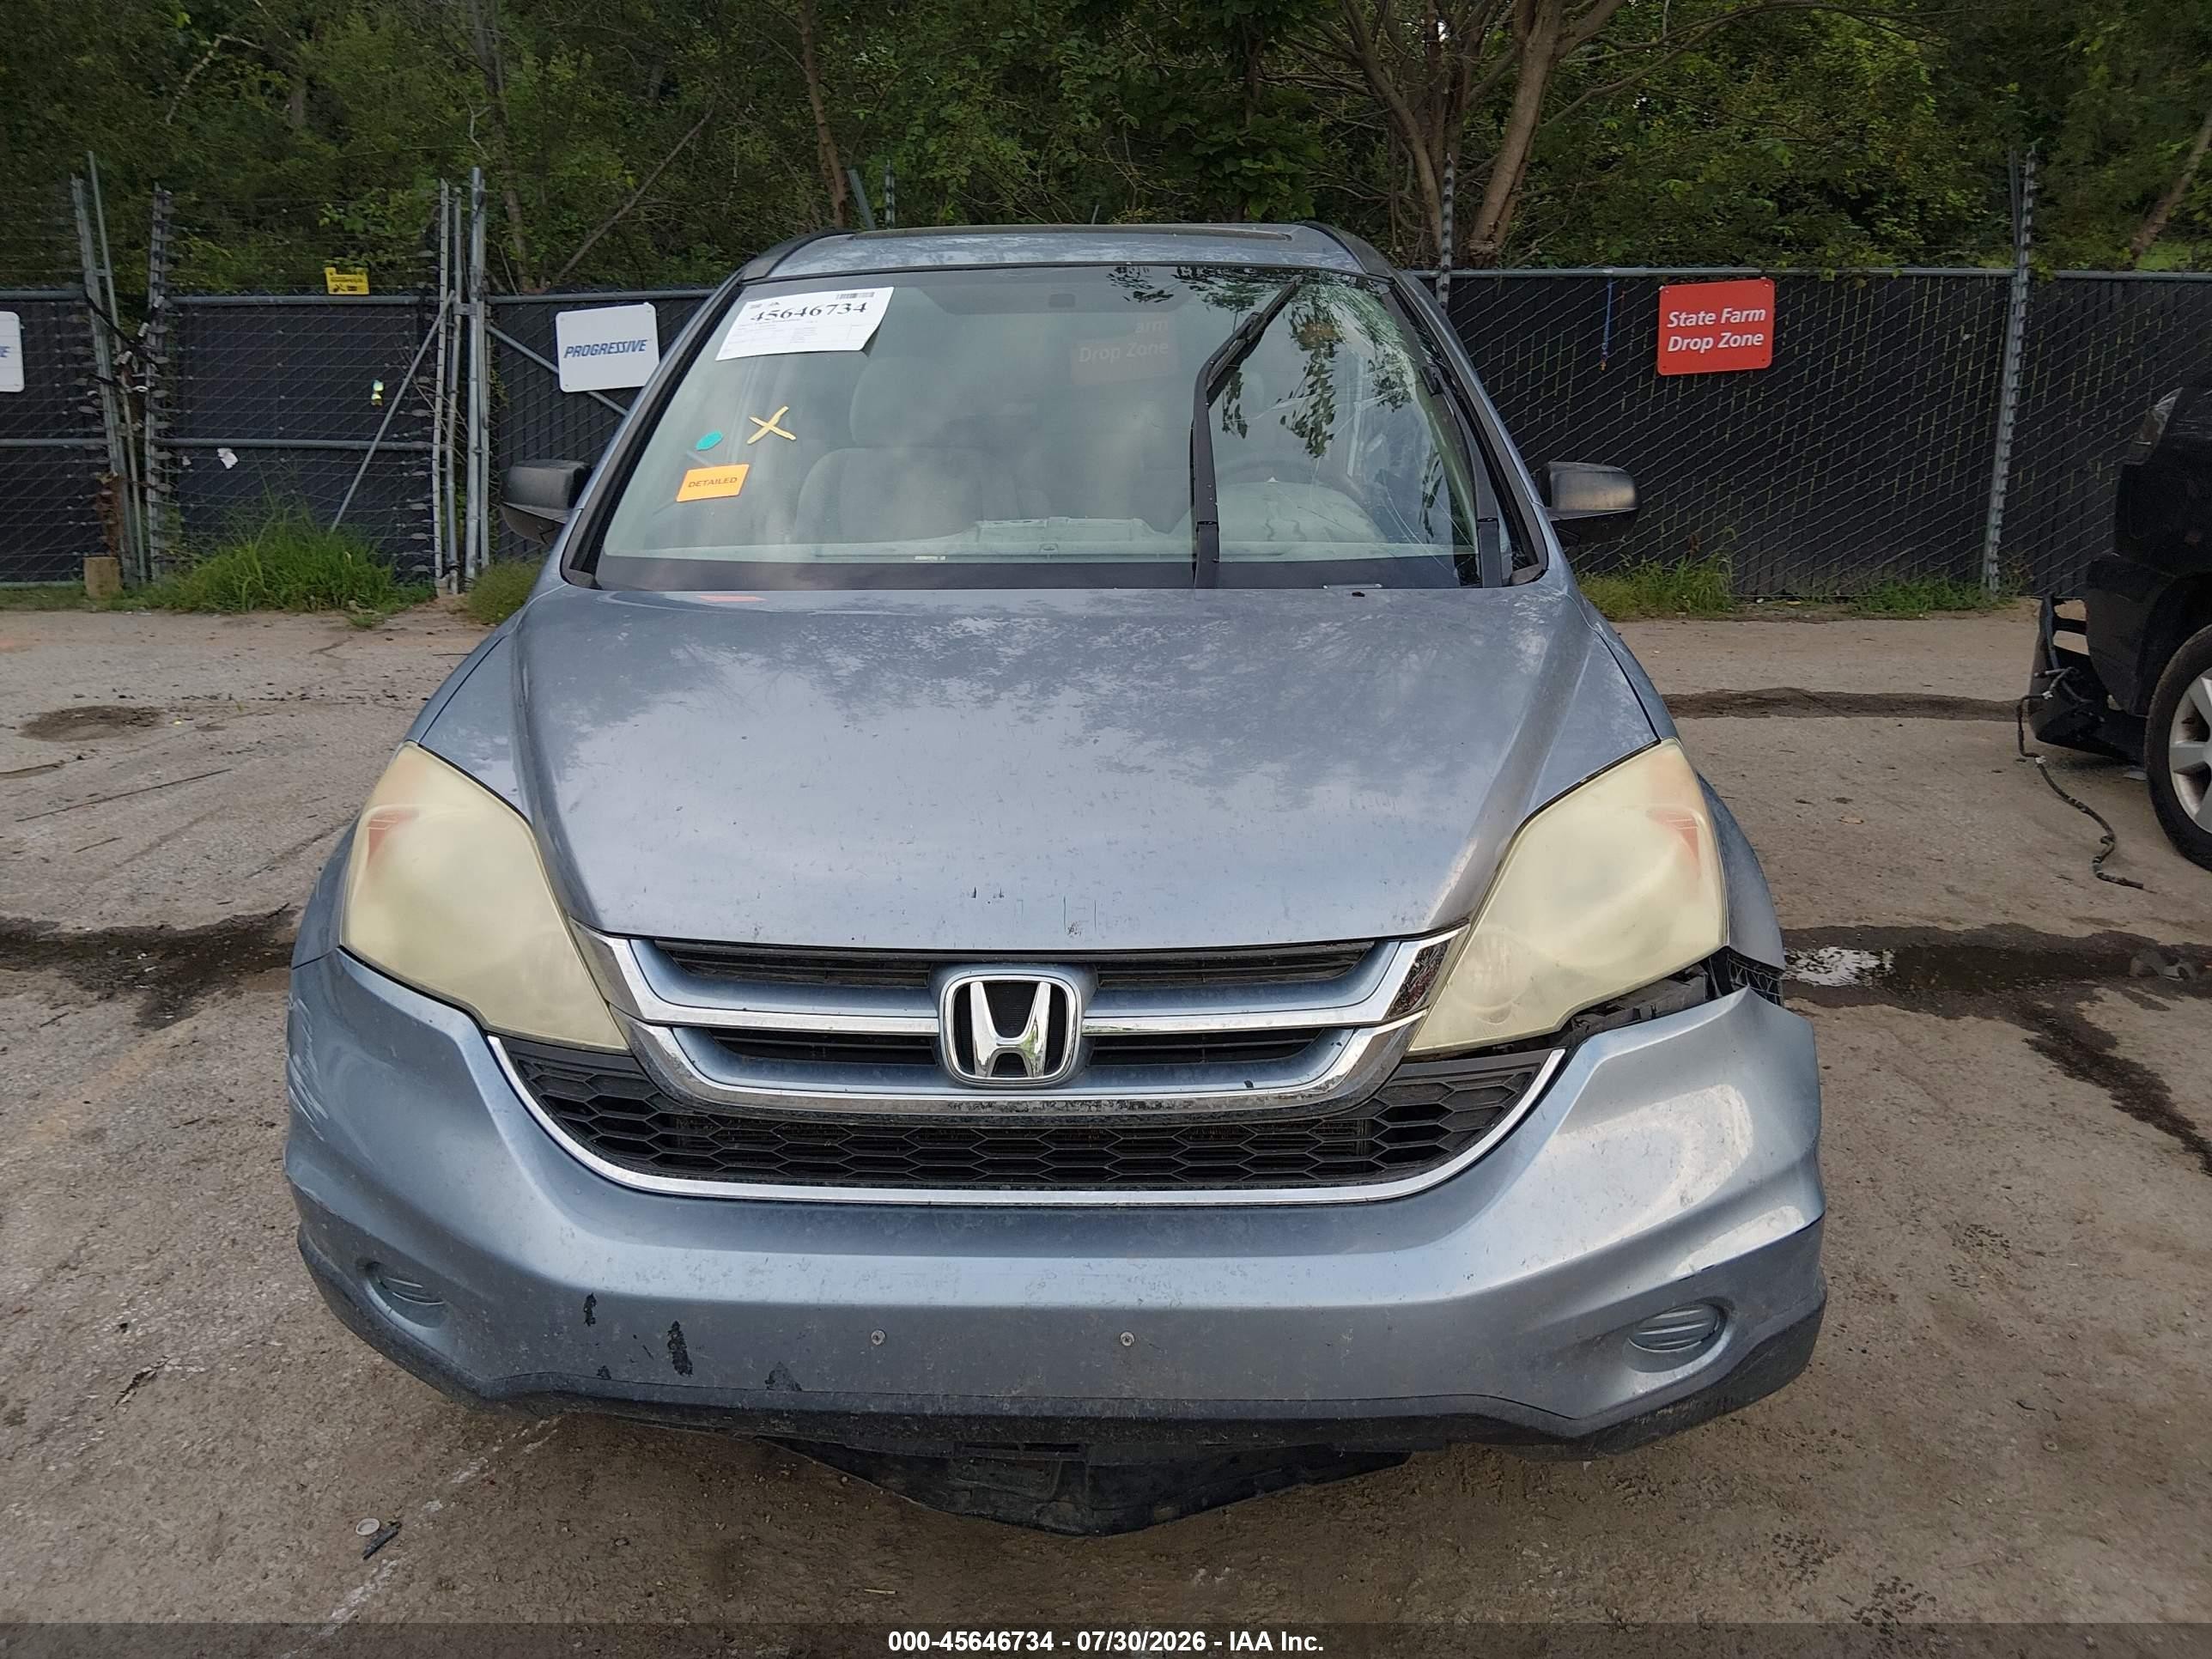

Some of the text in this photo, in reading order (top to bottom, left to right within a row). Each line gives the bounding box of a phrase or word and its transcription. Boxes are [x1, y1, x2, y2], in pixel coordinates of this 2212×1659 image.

[750, 301, 867, 322] 45646734
[1667, 307, 1766, 328] State Farm
[563, 339, 648, 359] PROGRESSIVE
[1667, 331, 1765, 354] Drop Zone
[1079, 343, 1169, 364] Drop Zone
[688, 477, 738, 488] DETAILED
